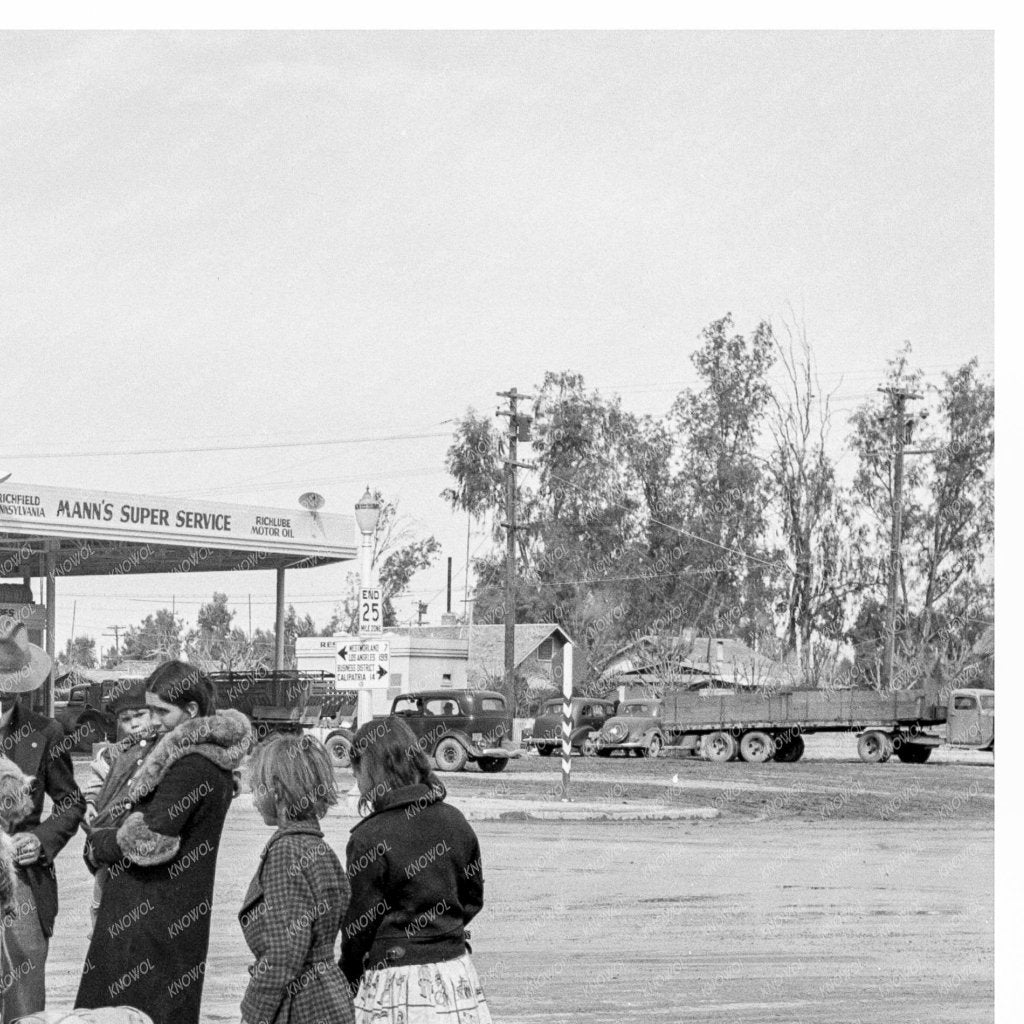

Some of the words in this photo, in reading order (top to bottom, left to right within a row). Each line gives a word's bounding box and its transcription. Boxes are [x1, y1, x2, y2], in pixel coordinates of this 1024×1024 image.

[56, 499, 114, 522] MANN'S
[120, 504, 170, 526] SUPER
[175, 510, 232, 531] SERVICE
[255, 516, 291, 528] RICHLUBE
[250, 526, 280, 537] MOTOR
[281, 529, 295, 538] OIL
[362, 590, 379, 600] END
[362, 603, 379, 621] 25
